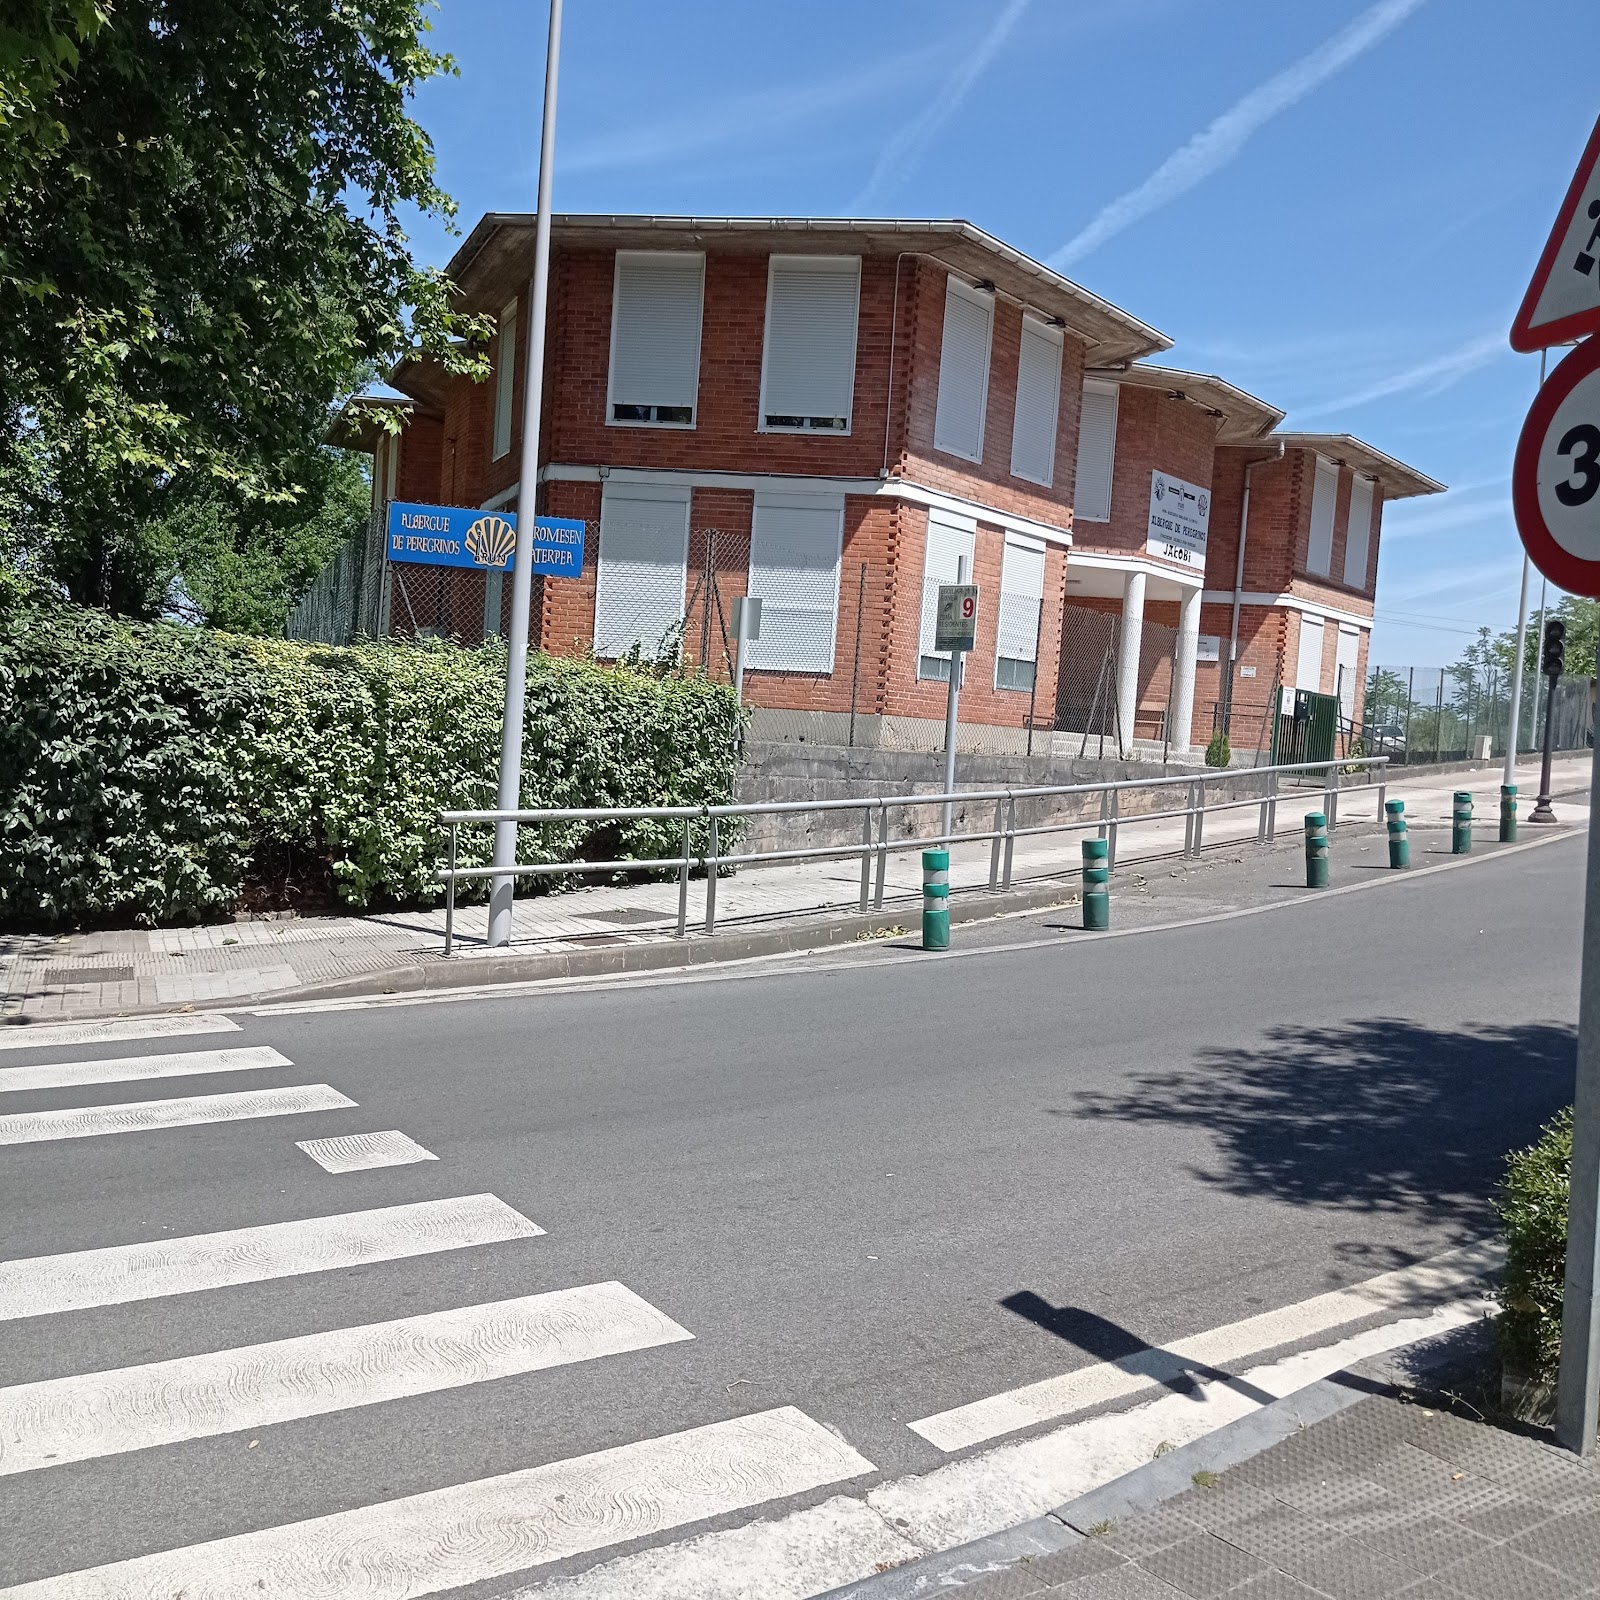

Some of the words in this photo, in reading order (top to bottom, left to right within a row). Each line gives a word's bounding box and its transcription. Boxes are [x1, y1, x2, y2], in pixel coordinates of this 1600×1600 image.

[401, 513, 451, 532] ALBERGUE
[1174, 523, 1181, 533] DE
[392, 535, 403, 550] DE
[406, 536, 461, 555] PEREGRINOS
[533, 525, 583, 545] ROMESEN
[962, 597, 974, 618] 9
